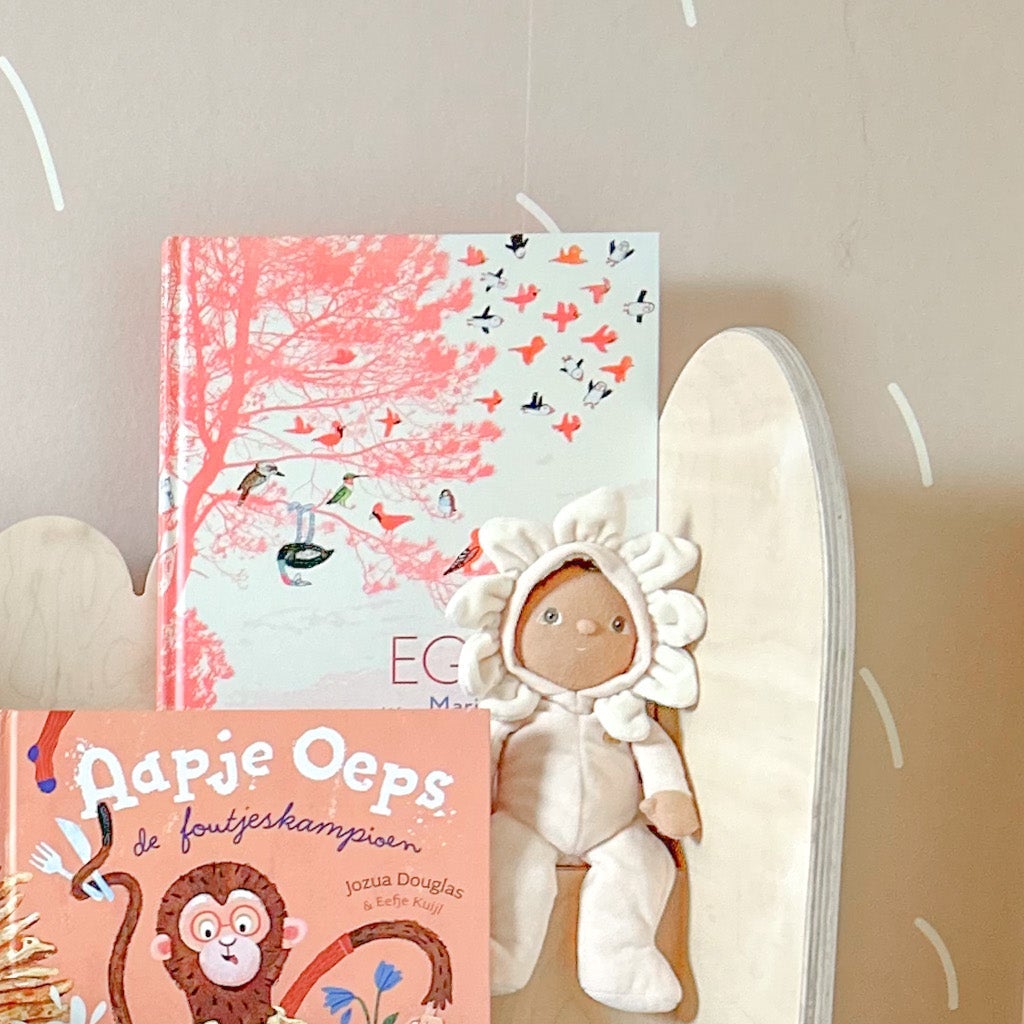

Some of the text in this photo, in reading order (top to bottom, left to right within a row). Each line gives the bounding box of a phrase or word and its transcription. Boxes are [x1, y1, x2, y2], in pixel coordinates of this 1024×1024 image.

[76, 727, 454, 820] Aapje Oeps
[134, 802, 421, 857] de foutjeskampioen
[345, 872, 465, 900] Jozua Douglas
[363, 899, 373, 912] &
[376, 894, 410, 909] Eefje
